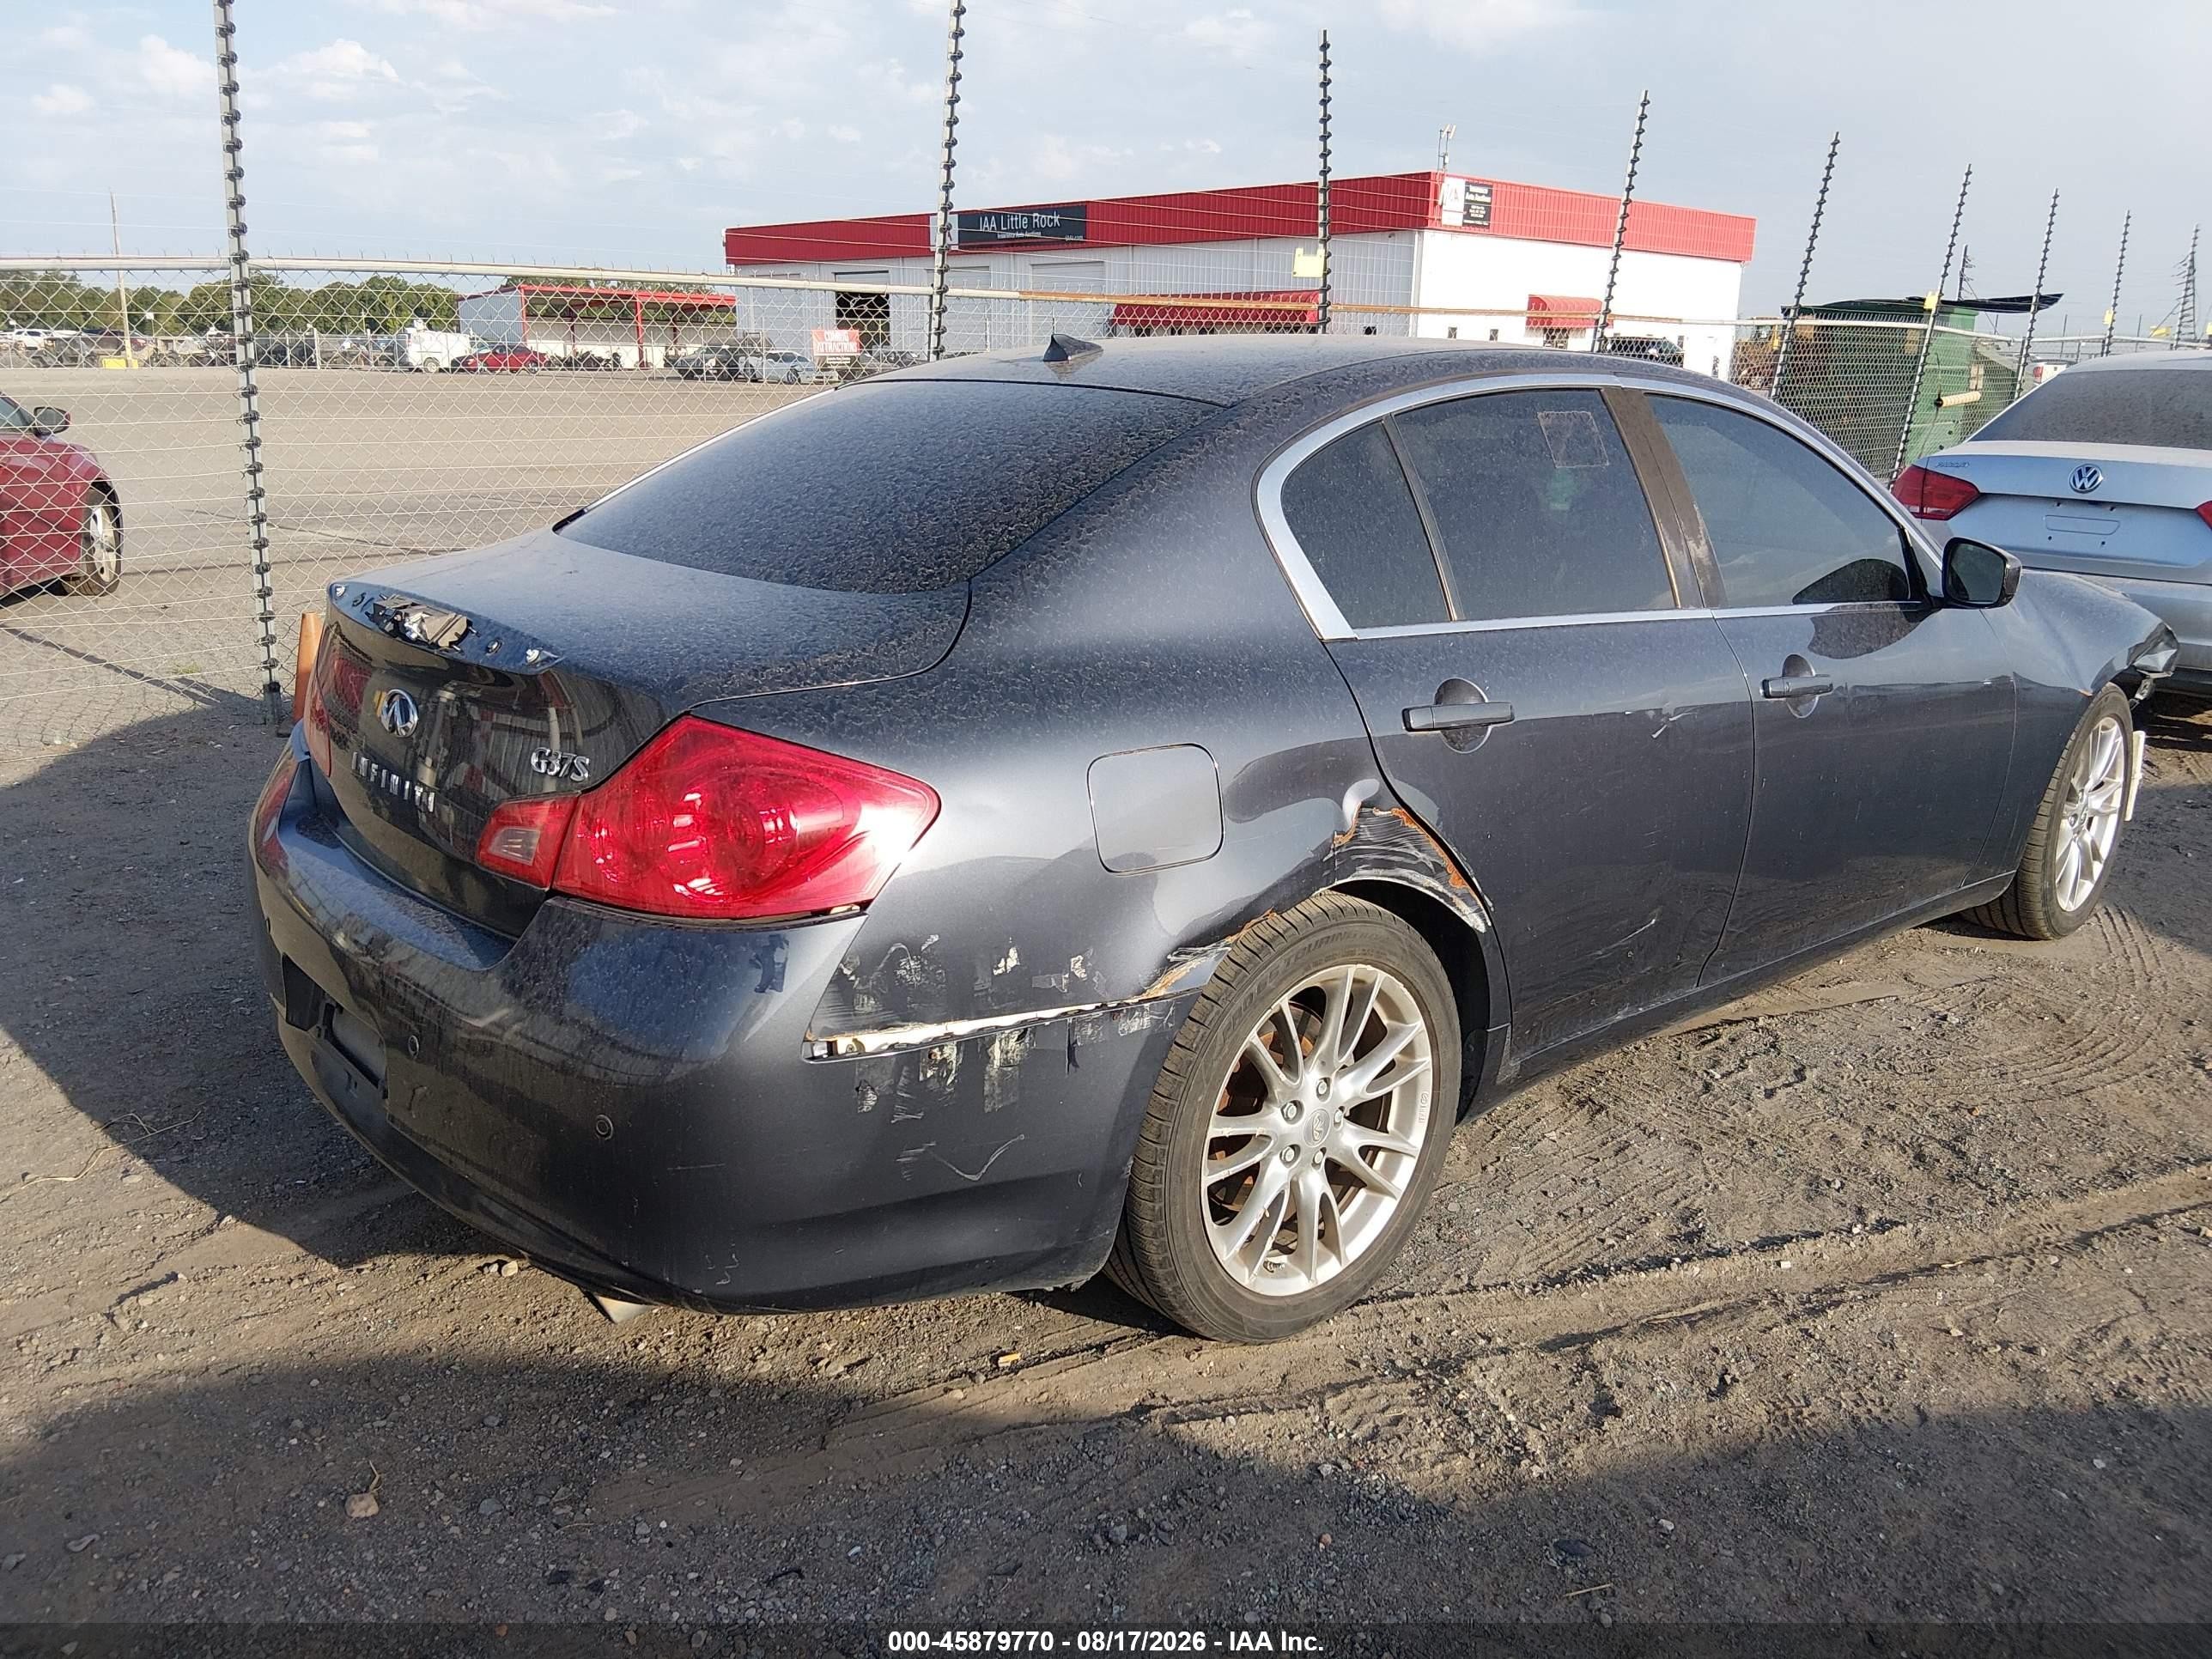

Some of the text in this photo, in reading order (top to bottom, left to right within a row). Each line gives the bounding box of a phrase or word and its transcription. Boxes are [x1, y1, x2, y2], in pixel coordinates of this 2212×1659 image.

[979, 211, 1060, 231] IAA Little Rock
[350, 751, 436, 812] INFINITI
[530, 746, 591, 783] G37S
